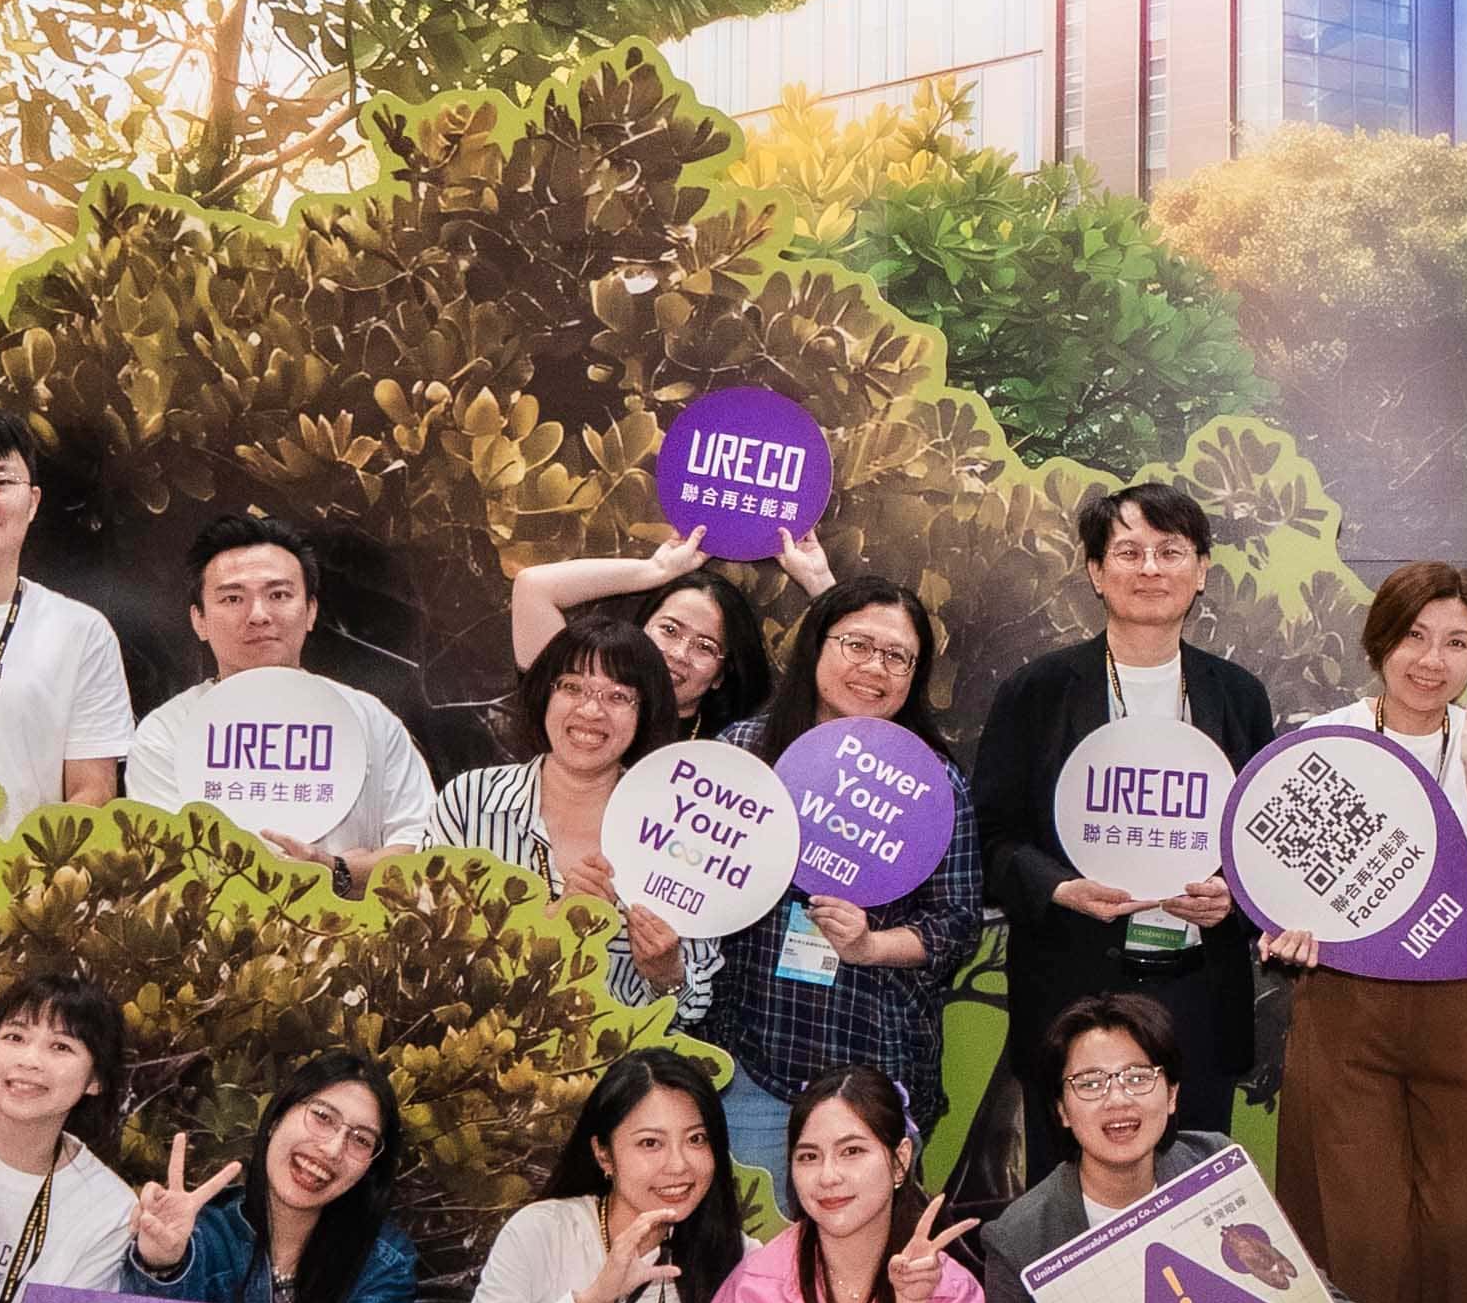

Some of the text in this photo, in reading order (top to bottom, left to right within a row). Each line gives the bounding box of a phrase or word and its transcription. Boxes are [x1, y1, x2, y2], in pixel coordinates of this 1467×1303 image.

[687, 429, 806, 493] URECO
[681, 482, 799, 521] 聯合再生能源
[207, 722, 333, 772] URECO
[835, 735, 930, 801] Power
[204, 780, 334, 802] 聯合再生能源
[670, 759, 774, 826] Power
[835, 769, 904, 825] Your
[1085, 764, 1209, 819] URECO
[672, 794, 748, 850] Your
[1083, 823, 1209, 852] 聯合再生能源
[801, 840, 861, 886] URECO
[1330, 826, 1409, 914] 聯合再生能源
[1346, 844, 1425, 929] Facebook
[644, 871, 705, 916] URECO
[1400, 892, 1463, 960] URECO
[1033, 1259, 1064, 1283] United
[1061, 1234, 1108, 1266] Renewable
[1107, 1216, 1140, 1244] Energy
[1156, 1195, 1174, 1211] Ltd.
